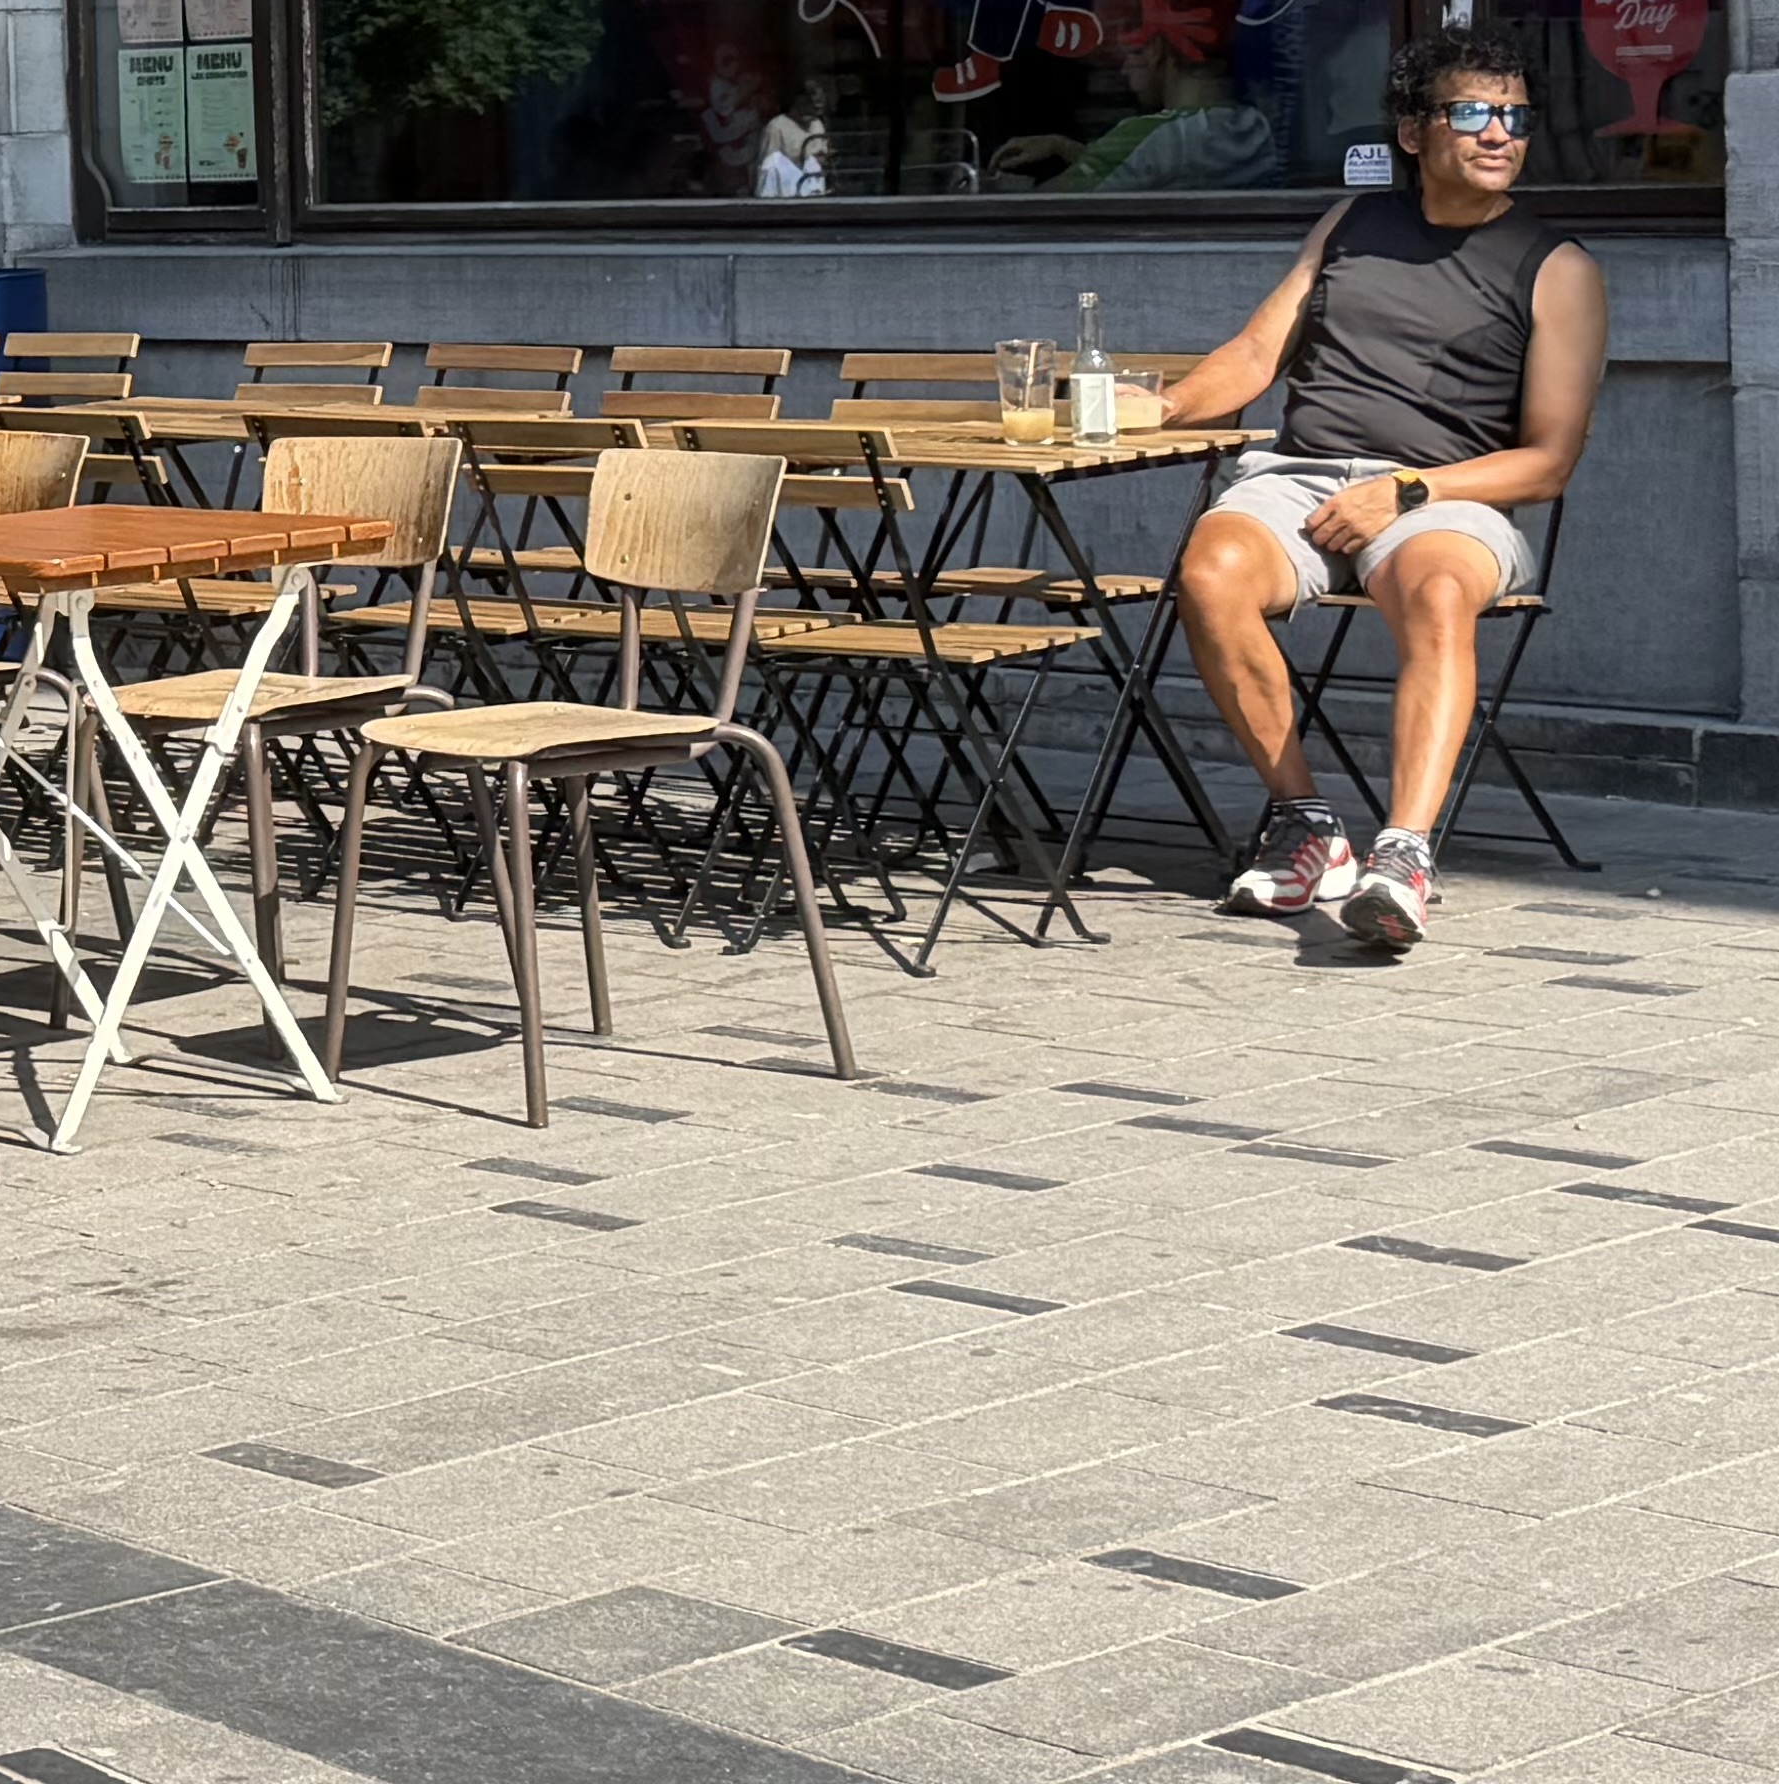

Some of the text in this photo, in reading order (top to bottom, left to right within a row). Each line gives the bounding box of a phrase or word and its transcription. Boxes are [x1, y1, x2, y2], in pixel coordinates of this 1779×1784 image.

[1613, 1, 1677, 33] Day
[129, 55, 174, 74] MENU
[196, 52, 242, 71] MENU
[1348, 147, 1389, 160] AJL
